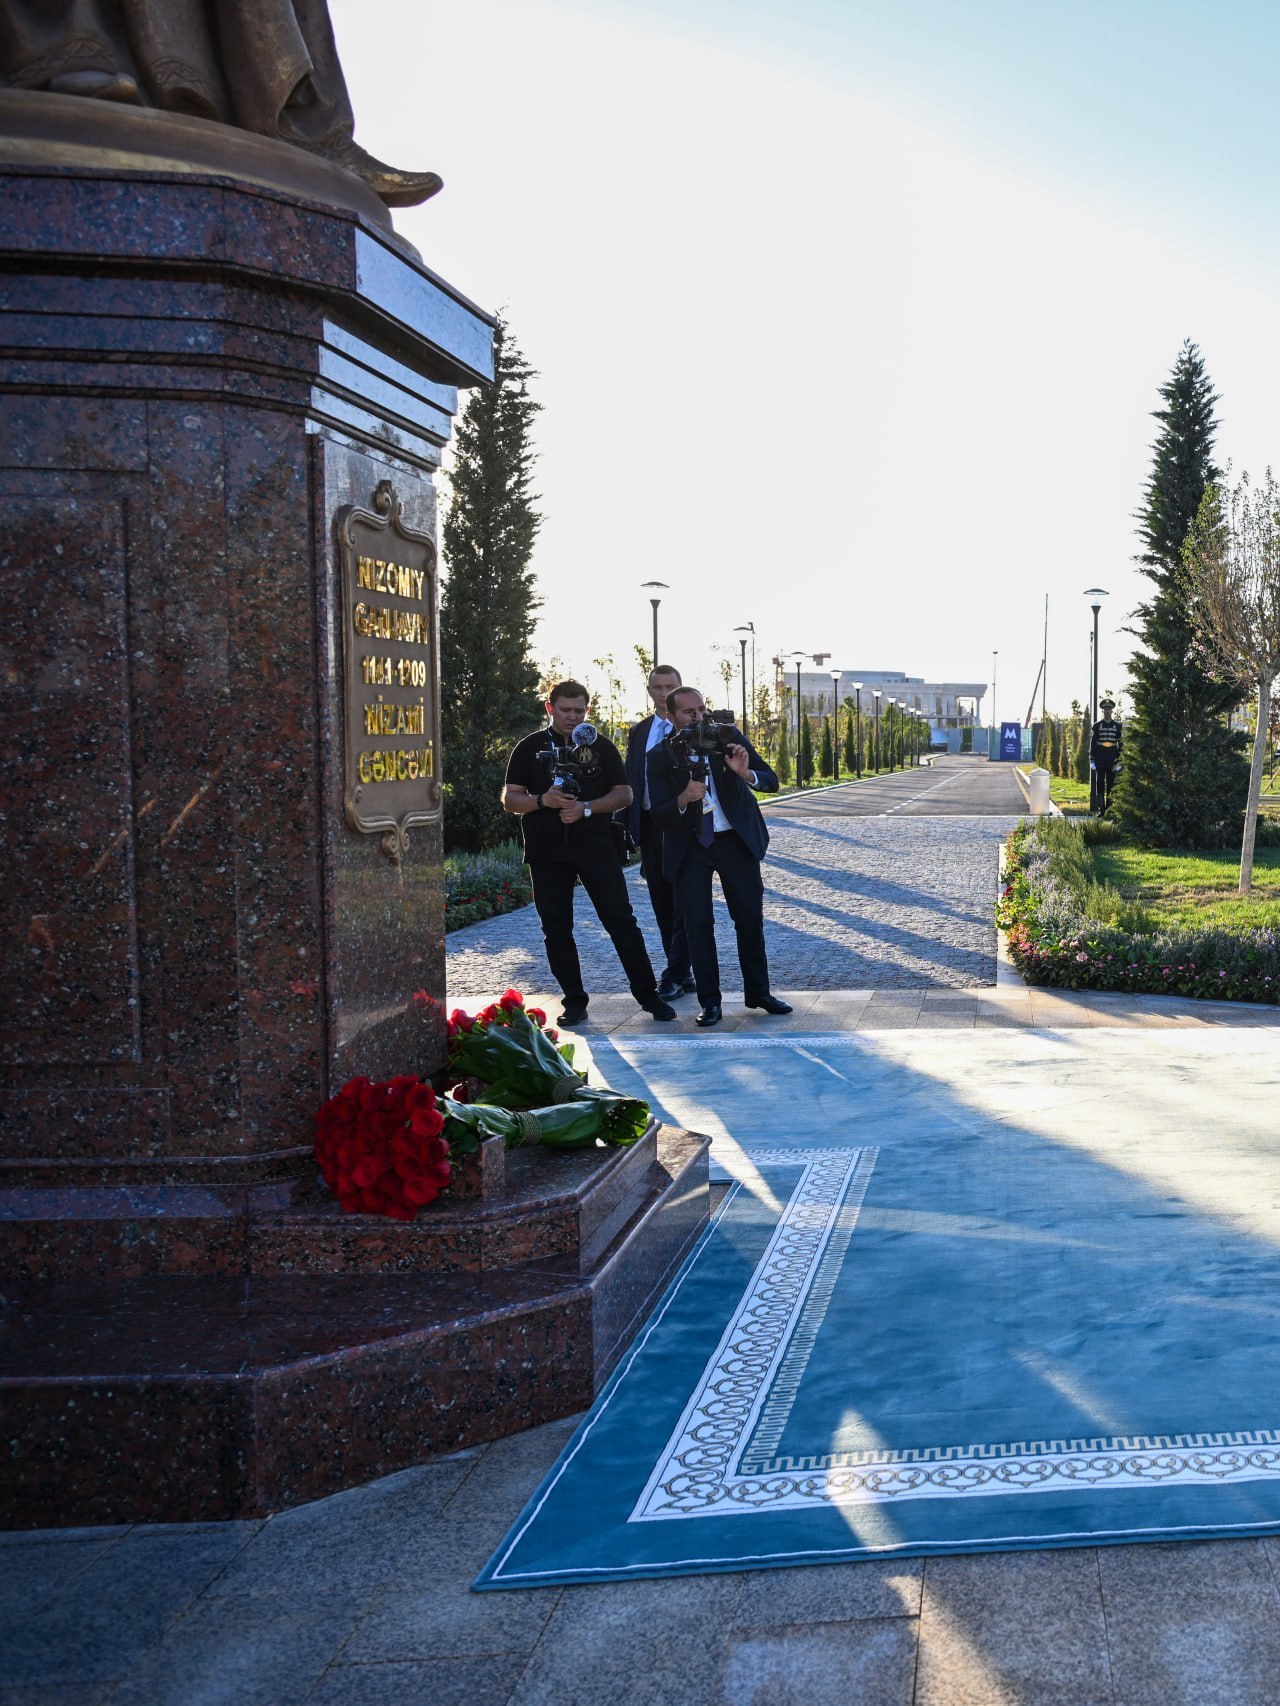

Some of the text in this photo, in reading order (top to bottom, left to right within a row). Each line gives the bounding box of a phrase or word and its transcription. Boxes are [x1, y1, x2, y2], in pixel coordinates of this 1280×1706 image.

[358, 555, 425, 600] NIZOMIY
[355, 602, 430, 645] GANJAVIY
[362, 655, 427, 688] 1141-1209
[364, 694, 425, 735] NİZAMİ
[1004, 728, 1017, 739] M
